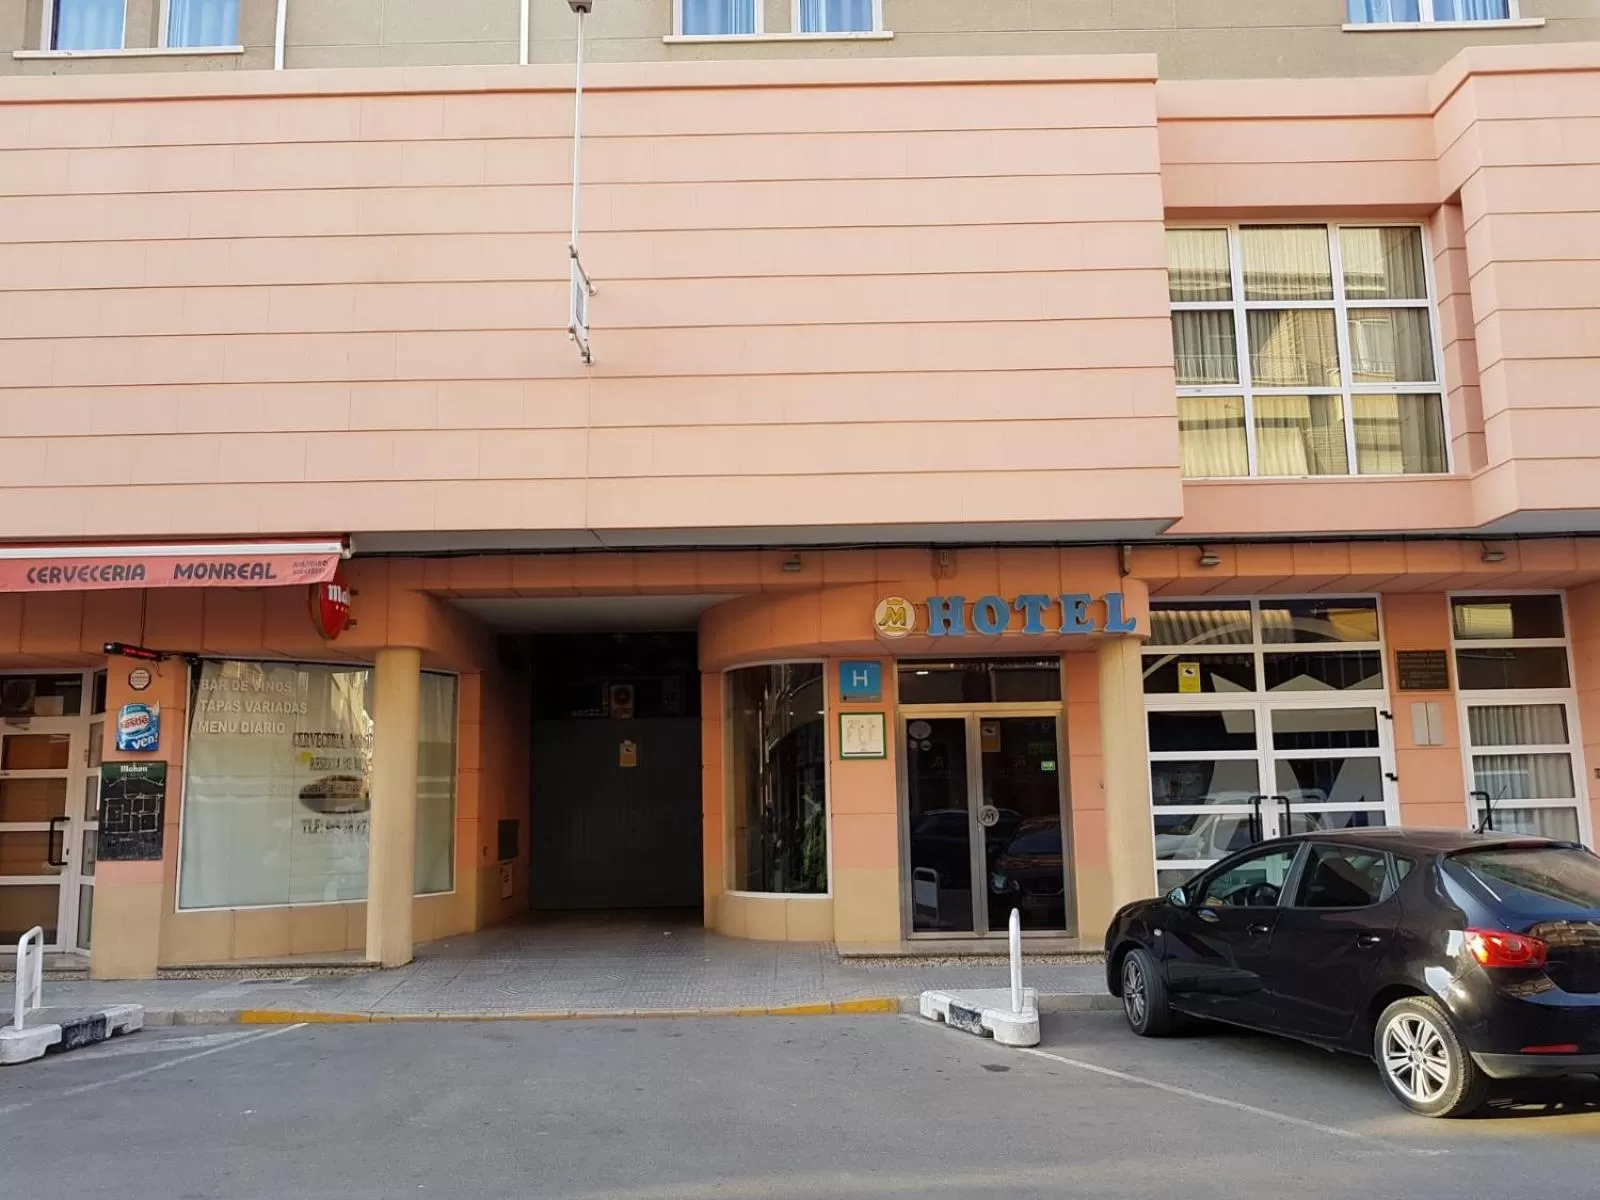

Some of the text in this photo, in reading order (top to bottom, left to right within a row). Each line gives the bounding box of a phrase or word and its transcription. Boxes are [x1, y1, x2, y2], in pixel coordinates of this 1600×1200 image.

[26, 563, 146, 584] CERVECERIA
[173, 561, 277, 581] MONREAL
[927, 593, 1137, 636] HOTEL
[201, 679, 292, 694] BAR DE VINOS
[852, 669, 869, 688] H
[199, 699, 308, 715] TAPAS VARIADAS
[240, 721, 286, 735] DIARIO
